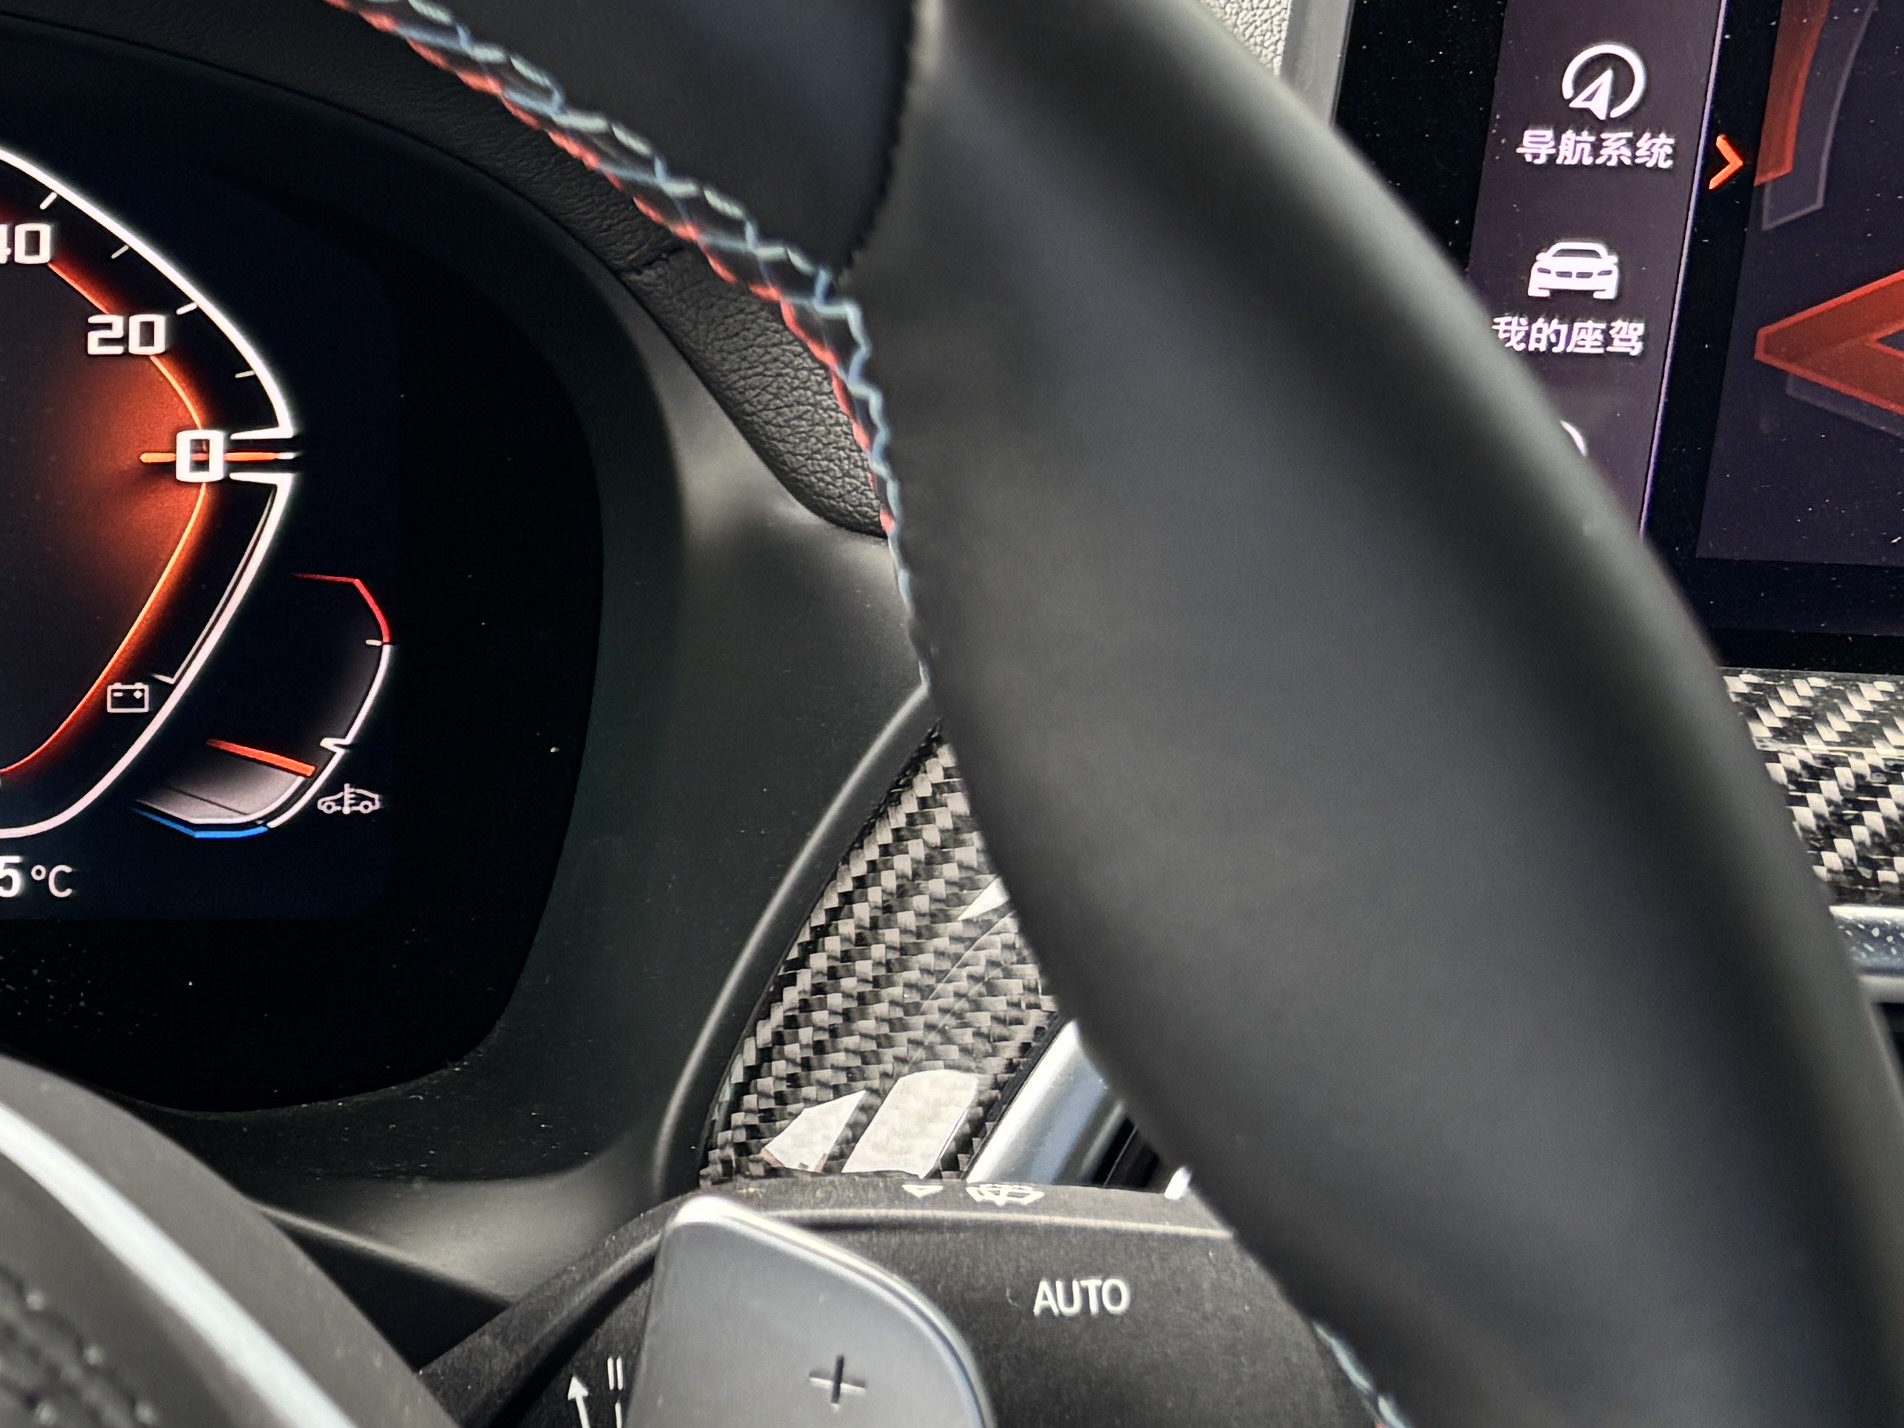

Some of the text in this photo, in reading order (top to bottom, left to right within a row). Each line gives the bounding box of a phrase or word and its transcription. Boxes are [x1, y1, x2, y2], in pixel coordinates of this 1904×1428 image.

[1515, 128, 1676, 169] 导航系统
[85, 313, 168, 357] 20
[1491, 315, 1646, 357] 我的座驾
[175, 429, 226, 485] 0
[30, 864, 73, 898] °C
[1033, 1276, 1131, 1317] AUTO
